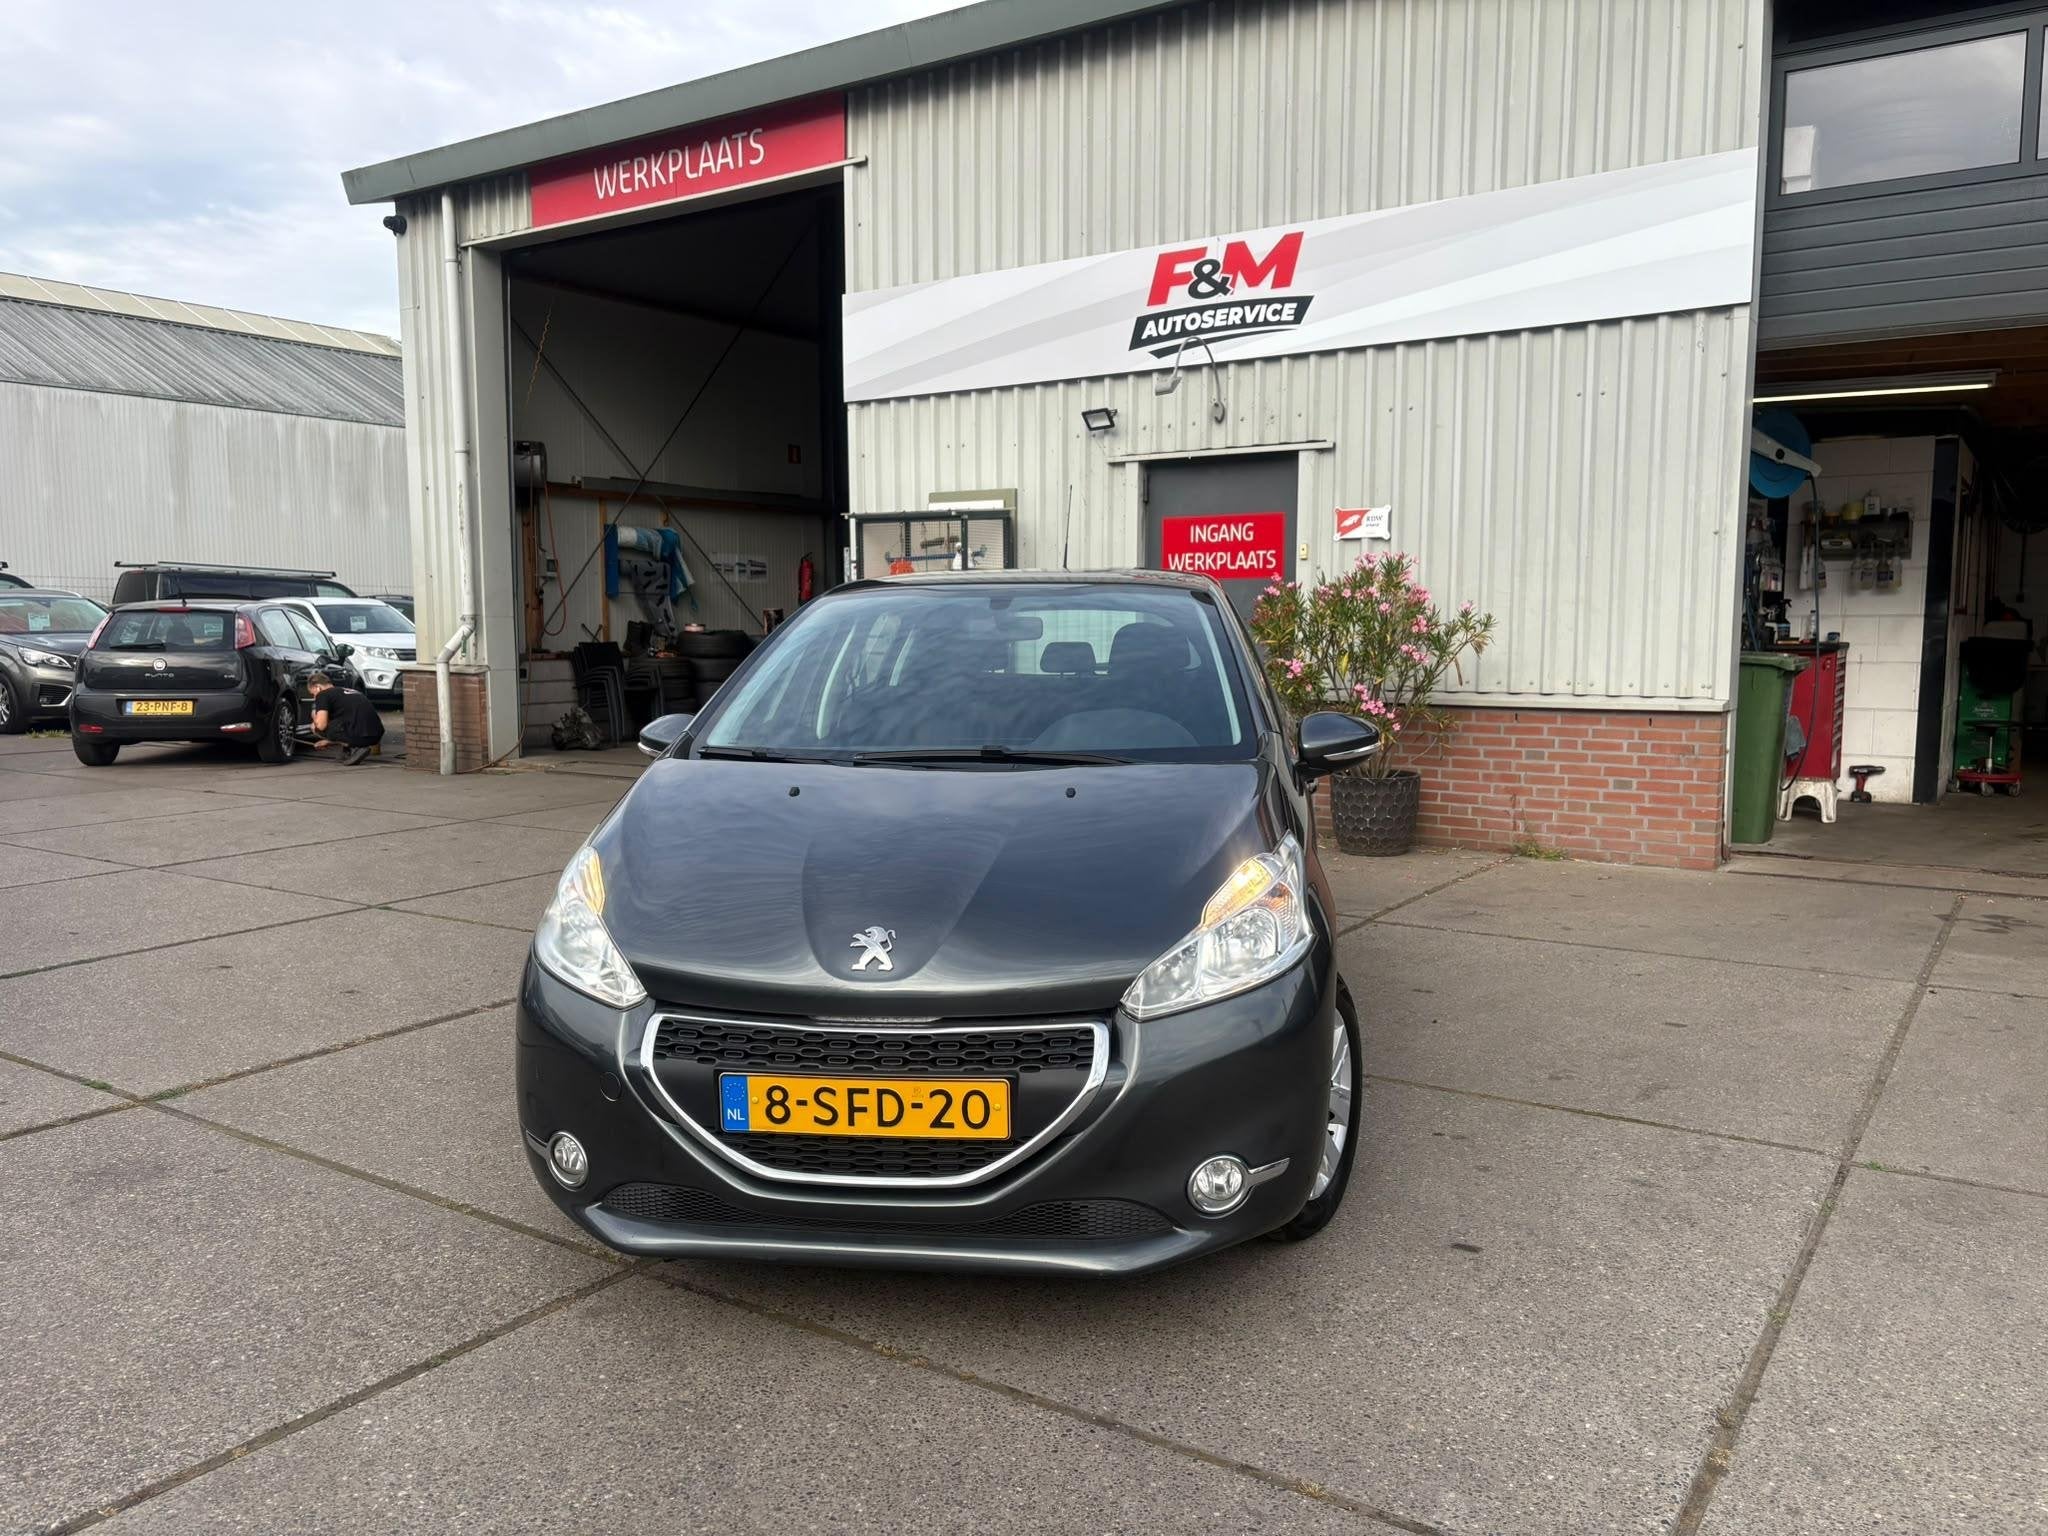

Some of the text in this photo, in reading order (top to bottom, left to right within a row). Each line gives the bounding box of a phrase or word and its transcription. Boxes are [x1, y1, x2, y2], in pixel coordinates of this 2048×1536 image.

[594, 128, 765, 200] WERKPLAATS
[1147, 231, 1304, 307] F&M
[1141, 302, 1298, 340] AUTOSERVICE
[1189, 522, 1254, 543] INGANG
[1168, 549, 1277, 571] WERKPLAATS
[136, 702, 188, 712] 23-PNF-8
[726, 1107, 746, 1121] NL
[764, 1084, 991, 1130] 8-SFD-20
